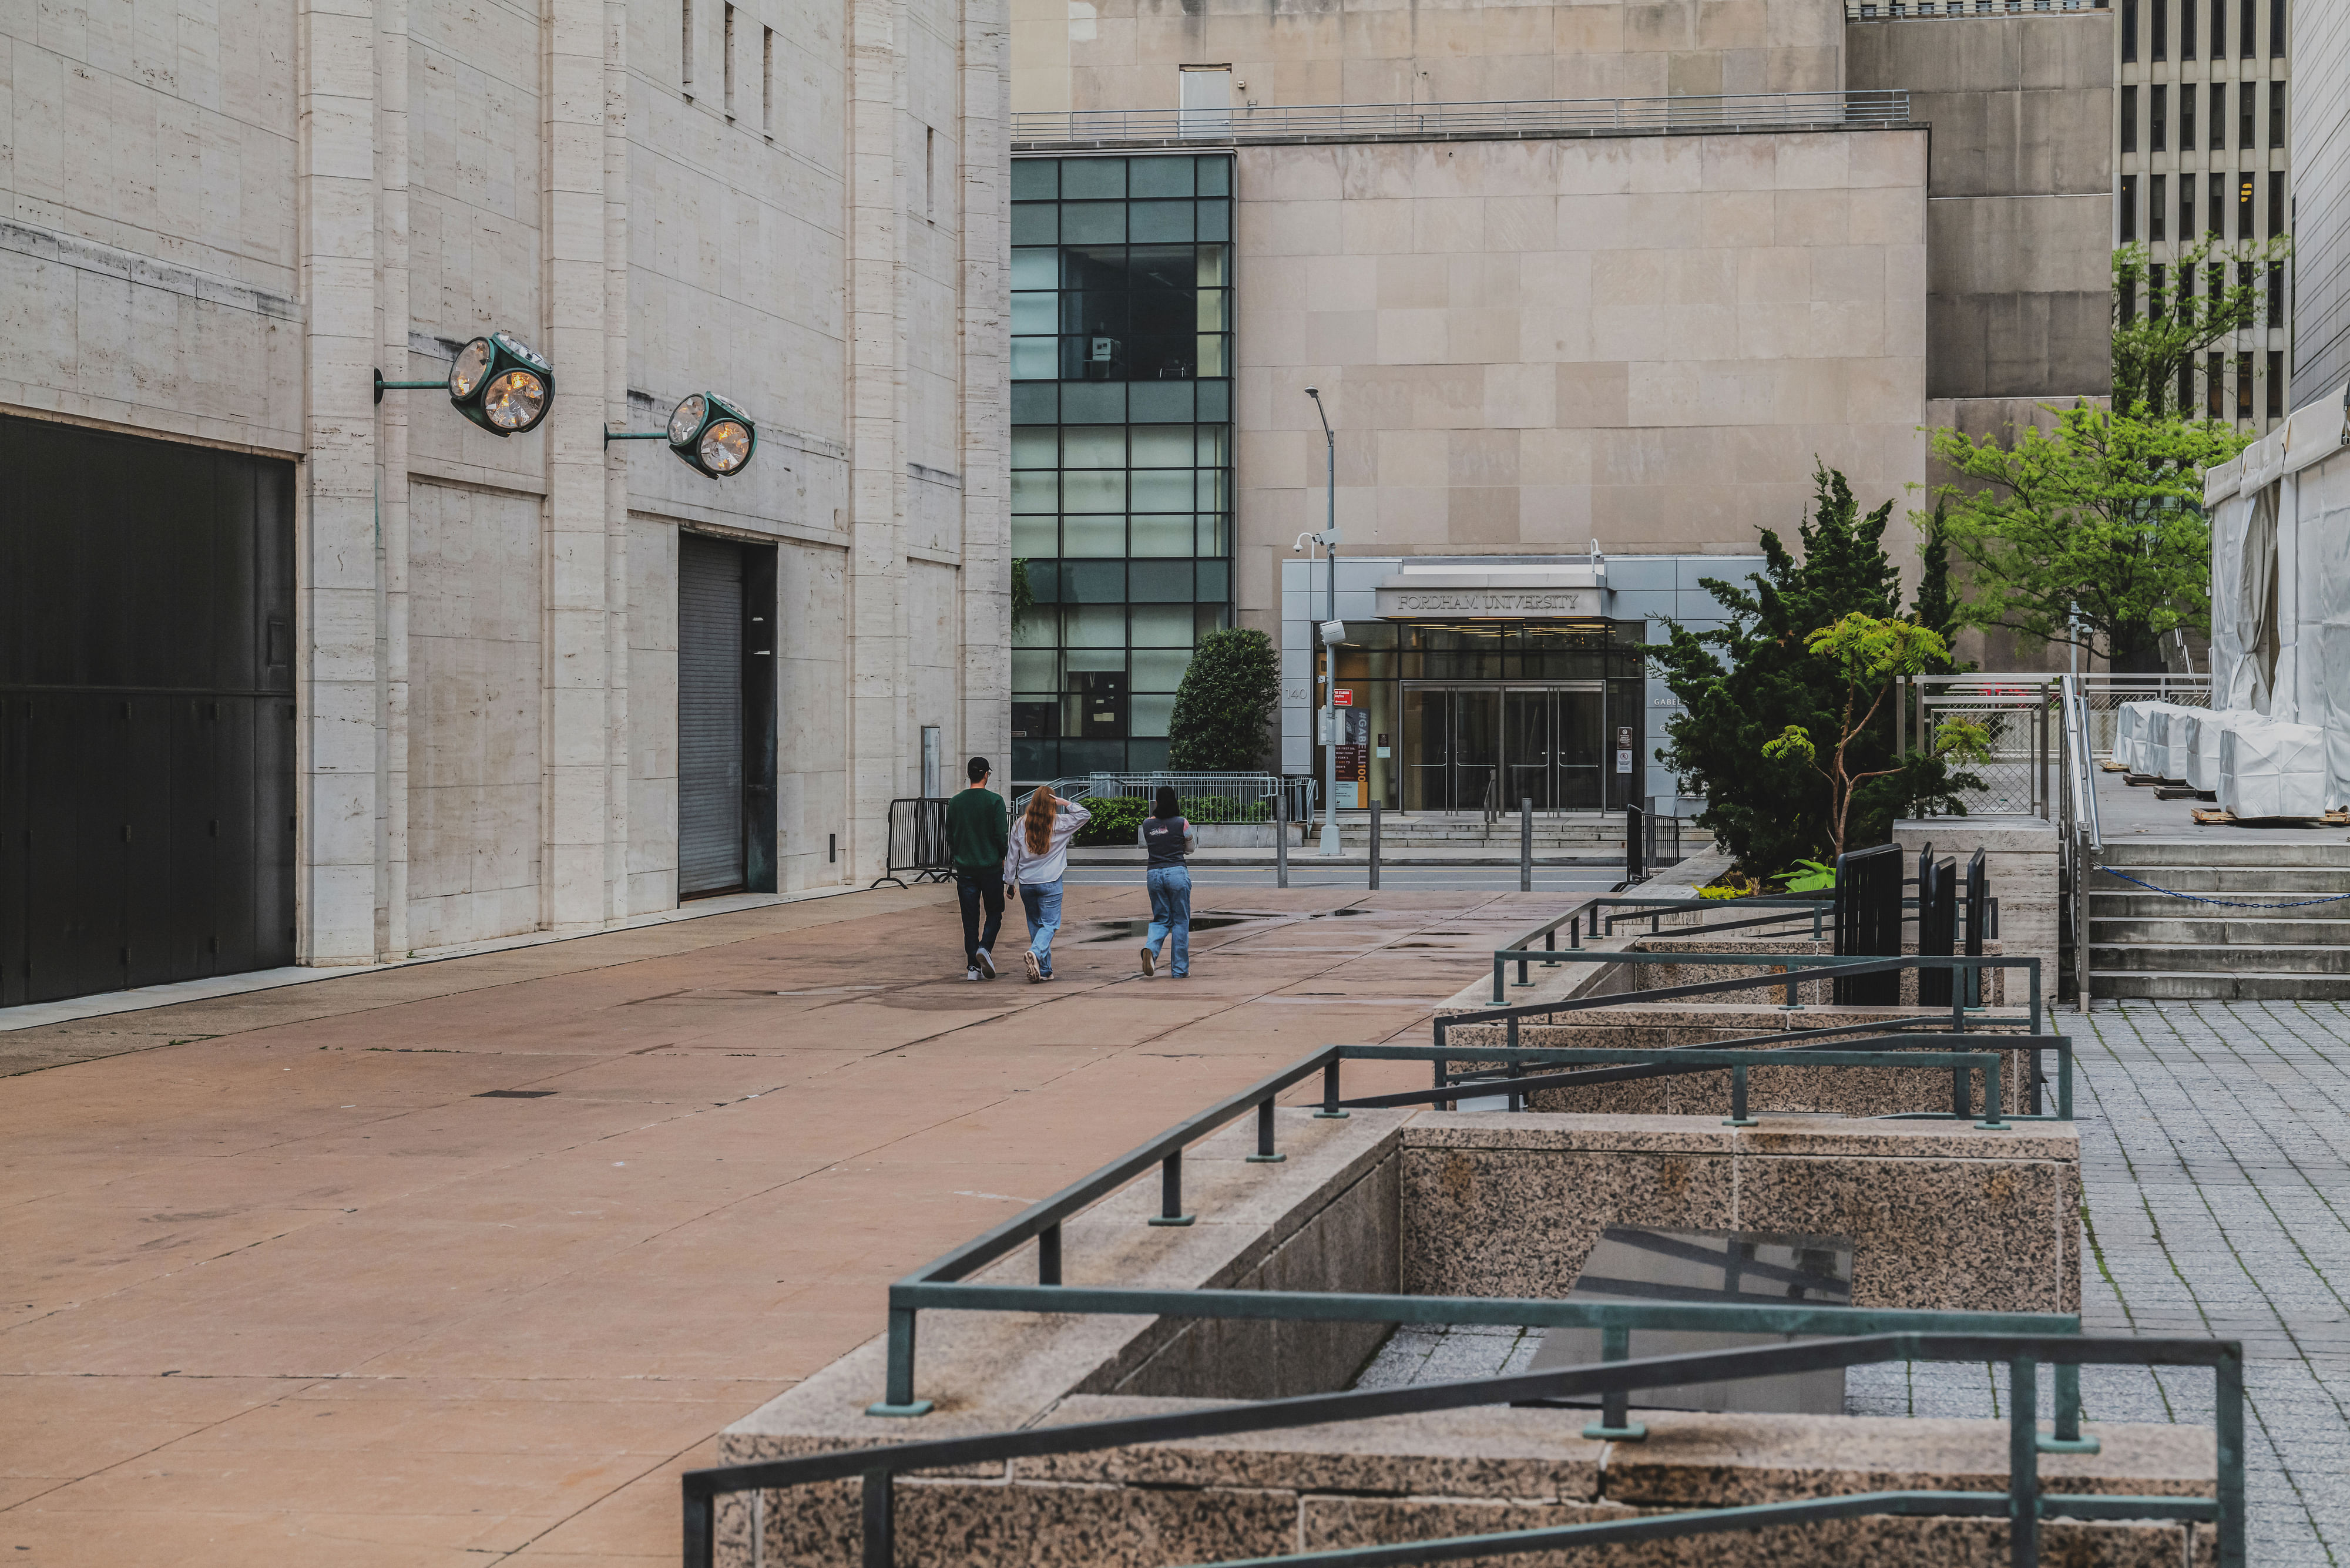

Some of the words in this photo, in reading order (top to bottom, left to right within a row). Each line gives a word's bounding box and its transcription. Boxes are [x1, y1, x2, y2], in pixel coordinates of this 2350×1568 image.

[1398, 595, 1478, 609] FORDHAM
[1482, 595, 1579, 609] UNIVERSITY
[1285, 688, 1308, 699] 140
[1358, 712, 1367, 782] #GABELLI100
